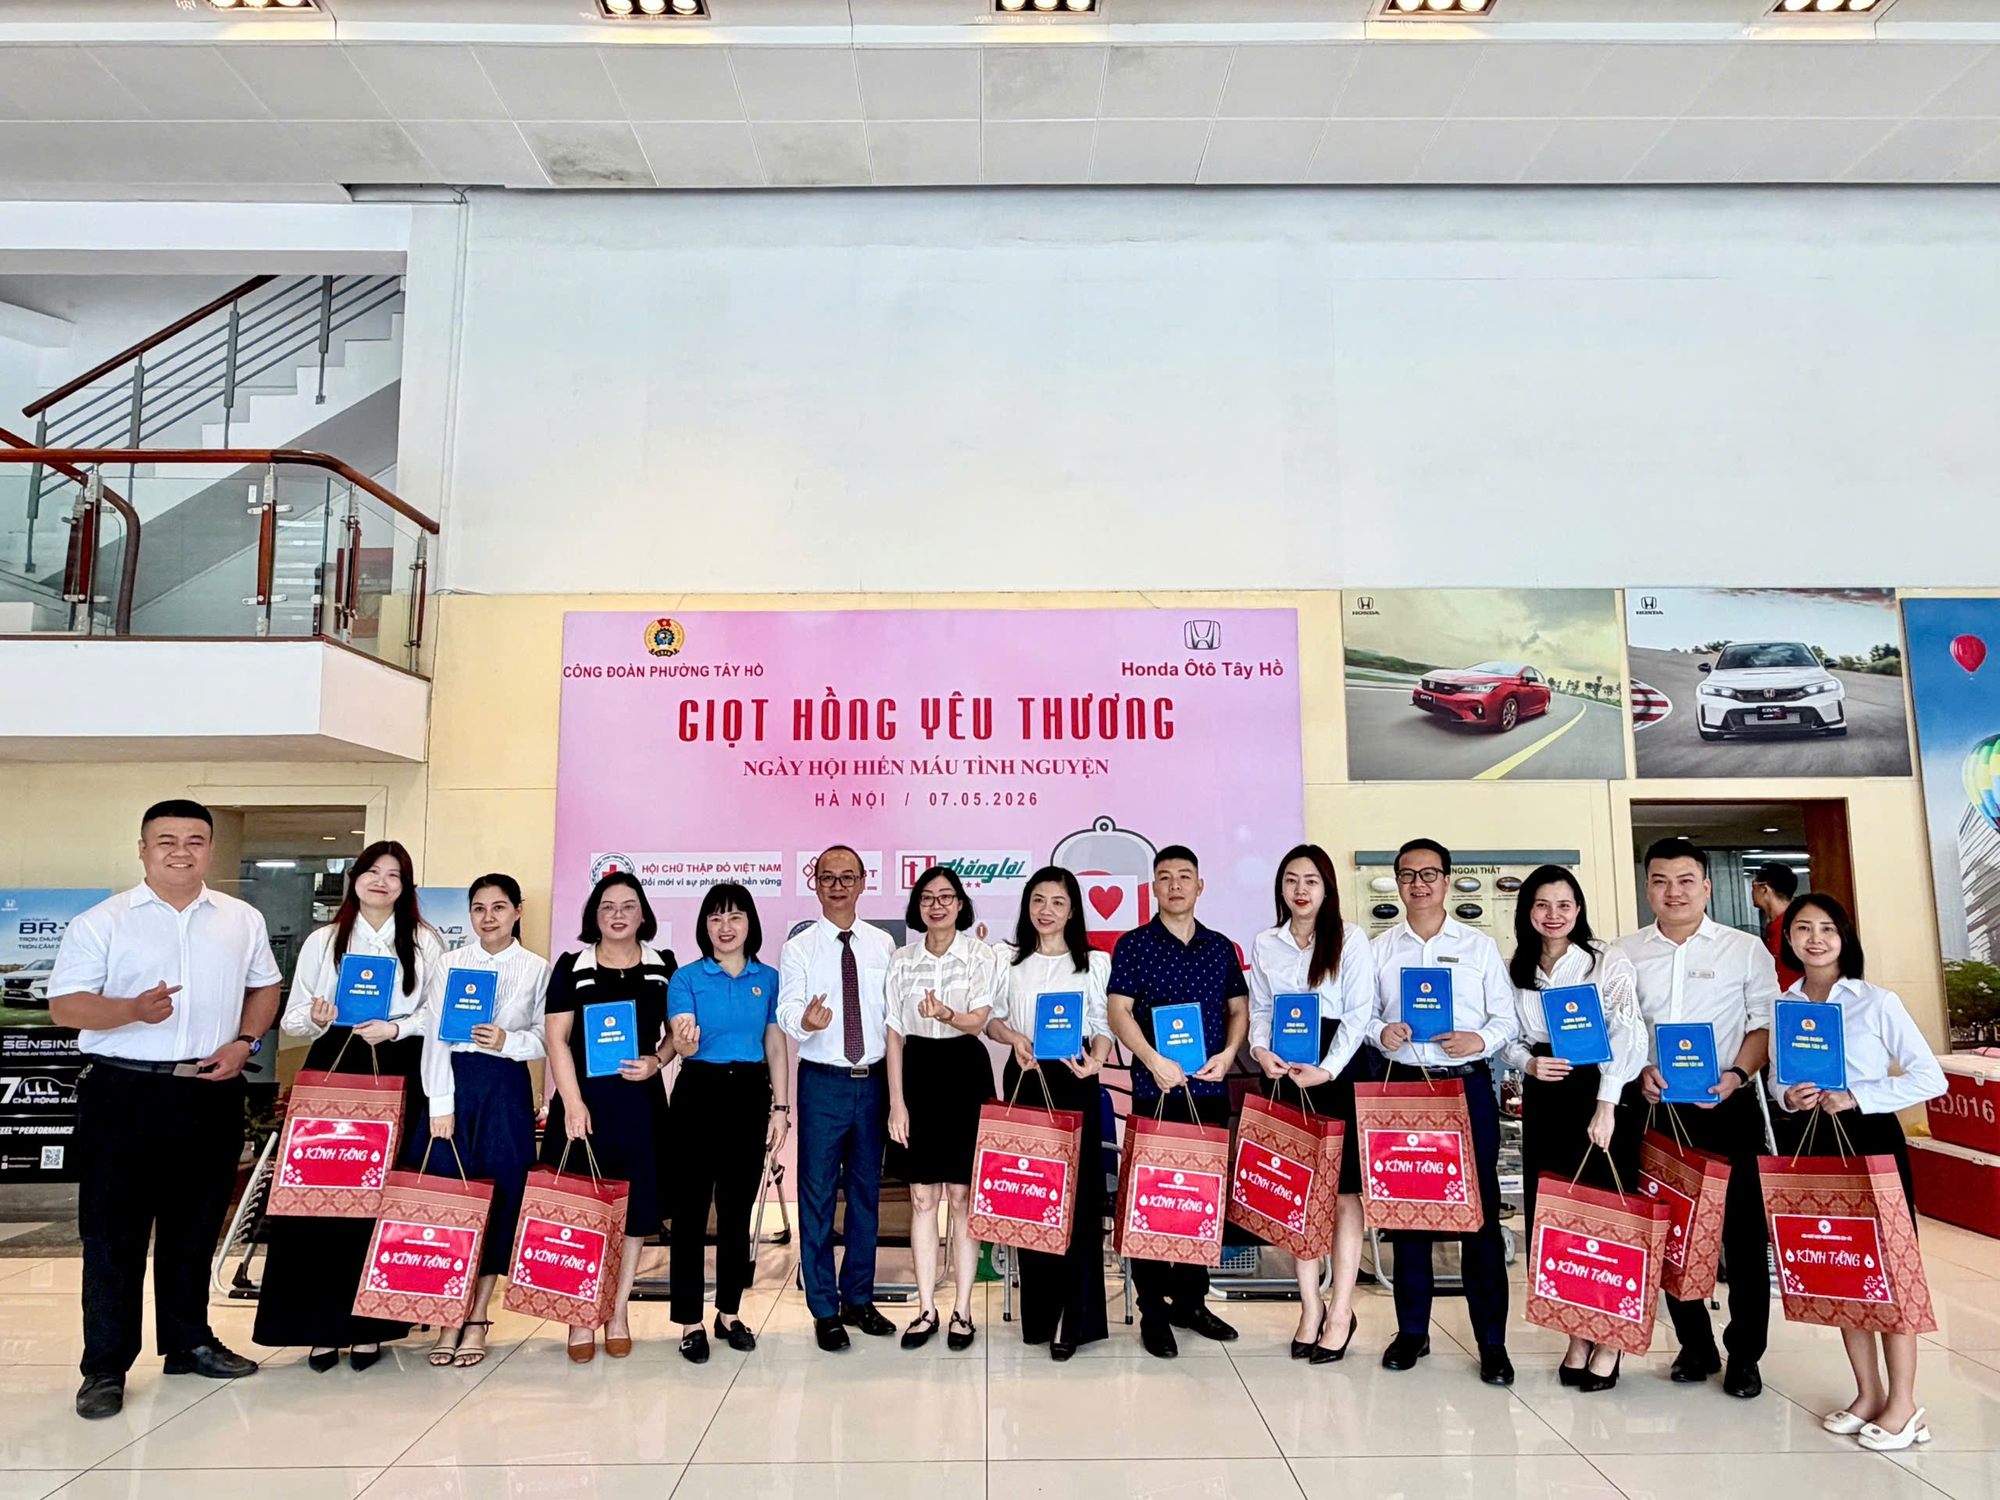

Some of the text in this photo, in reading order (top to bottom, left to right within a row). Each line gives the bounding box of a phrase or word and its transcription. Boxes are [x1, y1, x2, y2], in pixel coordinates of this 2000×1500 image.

[563, 662, 764, 678] CÔNG ĐOÀN PHƯỜNG TÂY HỒ
[1121, 659, 1284, 680] Honda Ôtô Tây Hồ
[678, 686, 1174, 749] GIỌT HỒNG YÊU THƯƠNG
[744, 755, 1109, 779] NGÀY HỘI HIẾN MÁU TÌNH NGUYỆN
[815, 789, 840, 807] HÀ
[852, 789, 885, 809] NỘI
[929, 792, 1038, 806] 07.05.2026
[642, 862, 782, 875] HỘI CHỮ THẬP ĐỎ VIỆT NAM
[19, 922, 70, 935] BR-
[3, 1040, 80, 1049] SENSING
[0, 1077, 21, 1104] 7
[304, 1146, 337, 1160] KÍNH
[1385, 1158, 1413, 1173] KÍNH
[993, 1178, 1019, 1194] KÍNH
[1248, 1171, 1270, 1190] KÍNH
[1149, 1194, 1176, 1208] KÍNH
[391, 1251, 422, 1266] KÍNH
[533, 1248, 560, 1264] KÍNH
[1796, 1247, 1827, 1264] KÍNH
[1557, 1259, 1590, 1278] KÍNH
